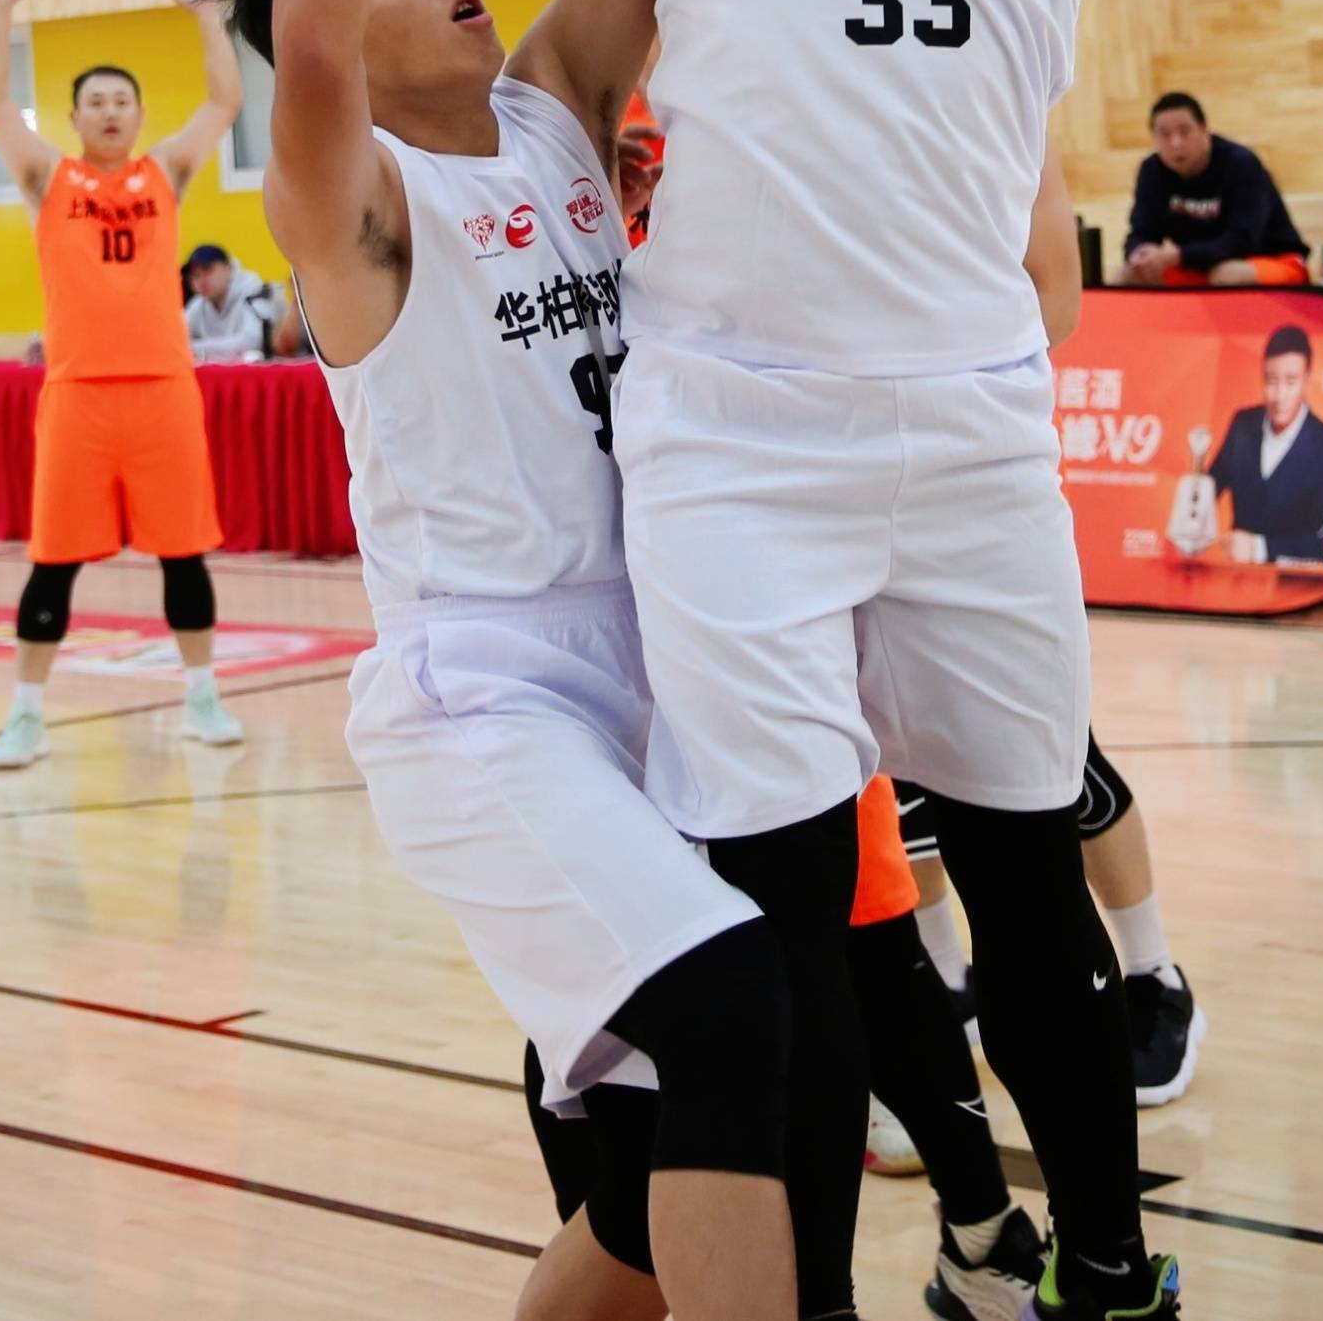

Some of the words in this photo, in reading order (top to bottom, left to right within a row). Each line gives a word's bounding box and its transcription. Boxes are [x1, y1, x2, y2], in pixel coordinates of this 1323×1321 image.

[101, 226, 137, 264] 10
[493, 257, 623, 350] 华柏裕钢
[569, 351, 627, 456] 9
